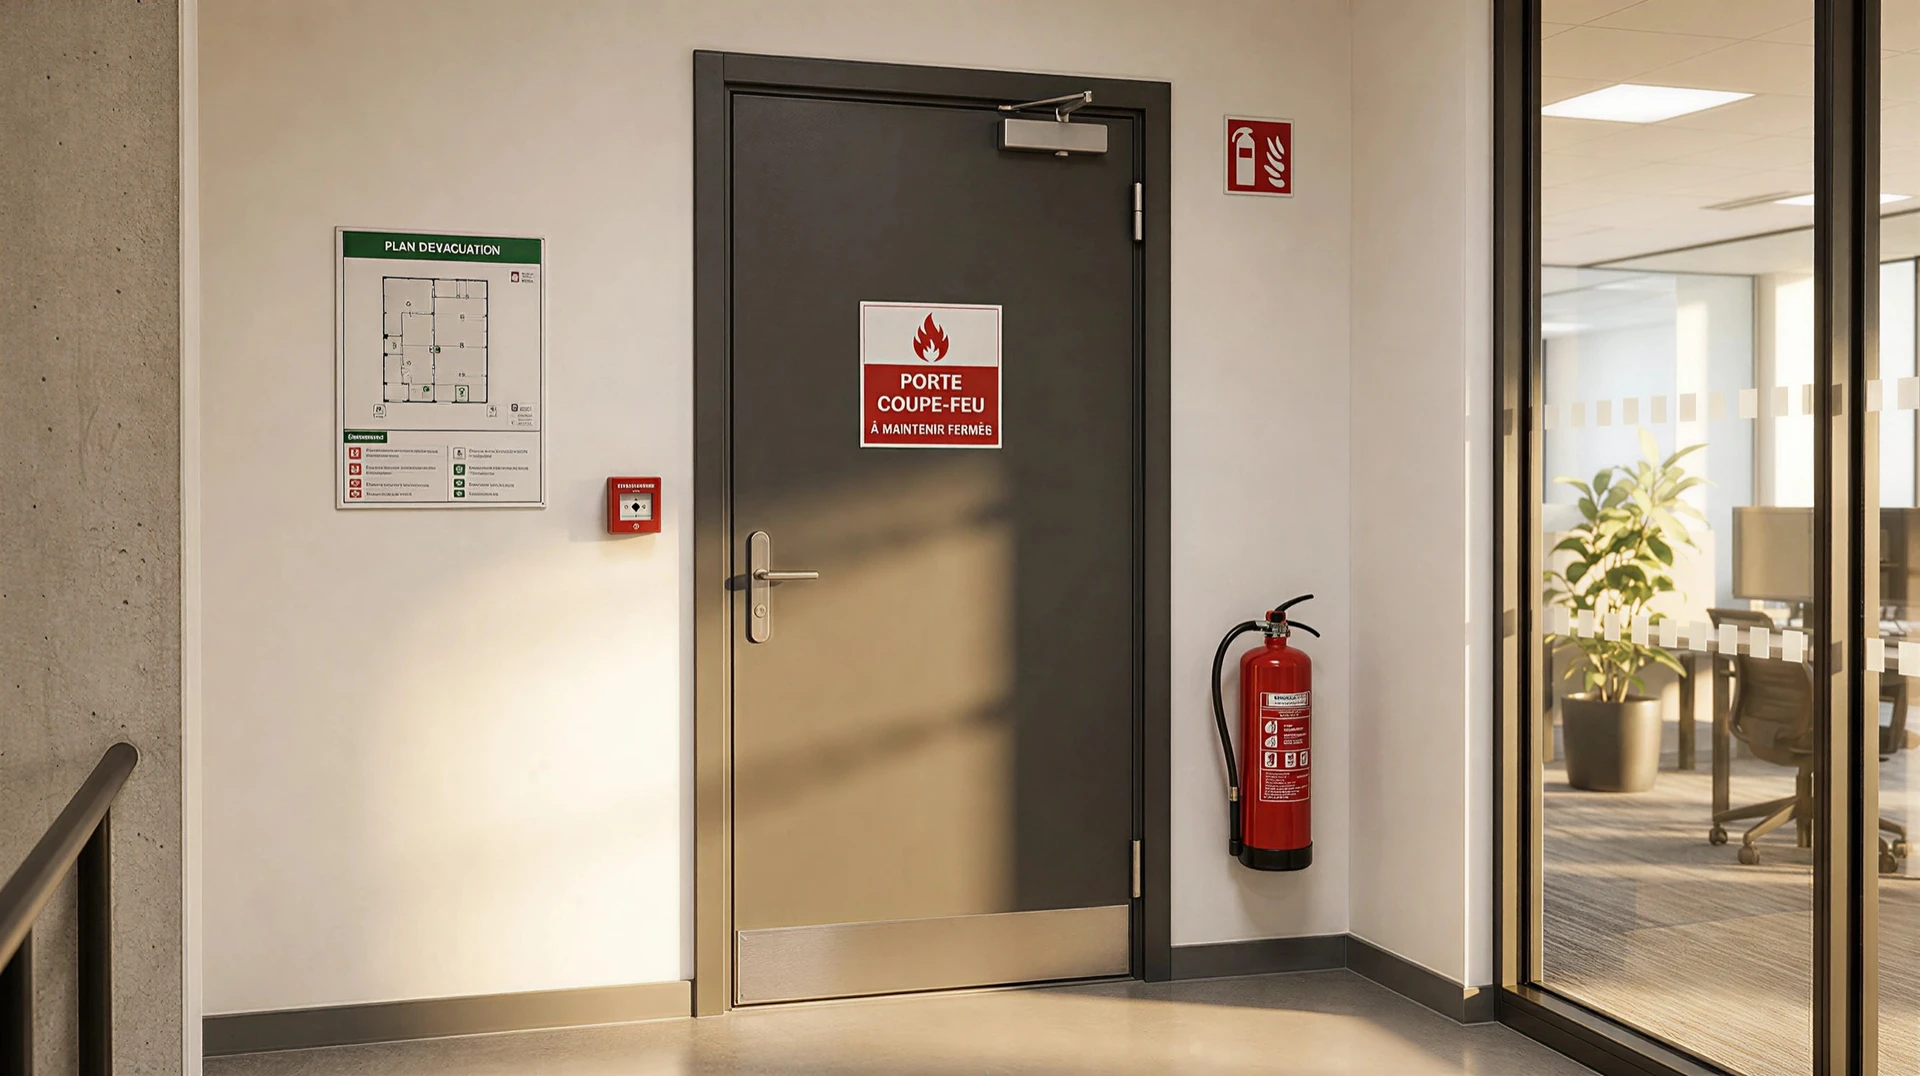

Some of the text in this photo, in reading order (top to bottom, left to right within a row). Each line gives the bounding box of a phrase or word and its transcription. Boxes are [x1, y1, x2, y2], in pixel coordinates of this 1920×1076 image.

[384, 240, 501, 256] PLAN DEVACUATION
[900, 373, 962, 390] PORTE
[877, 395, 985, 413] COUPE-FEU
[882, 423, 945, 435] MAINTENIR
